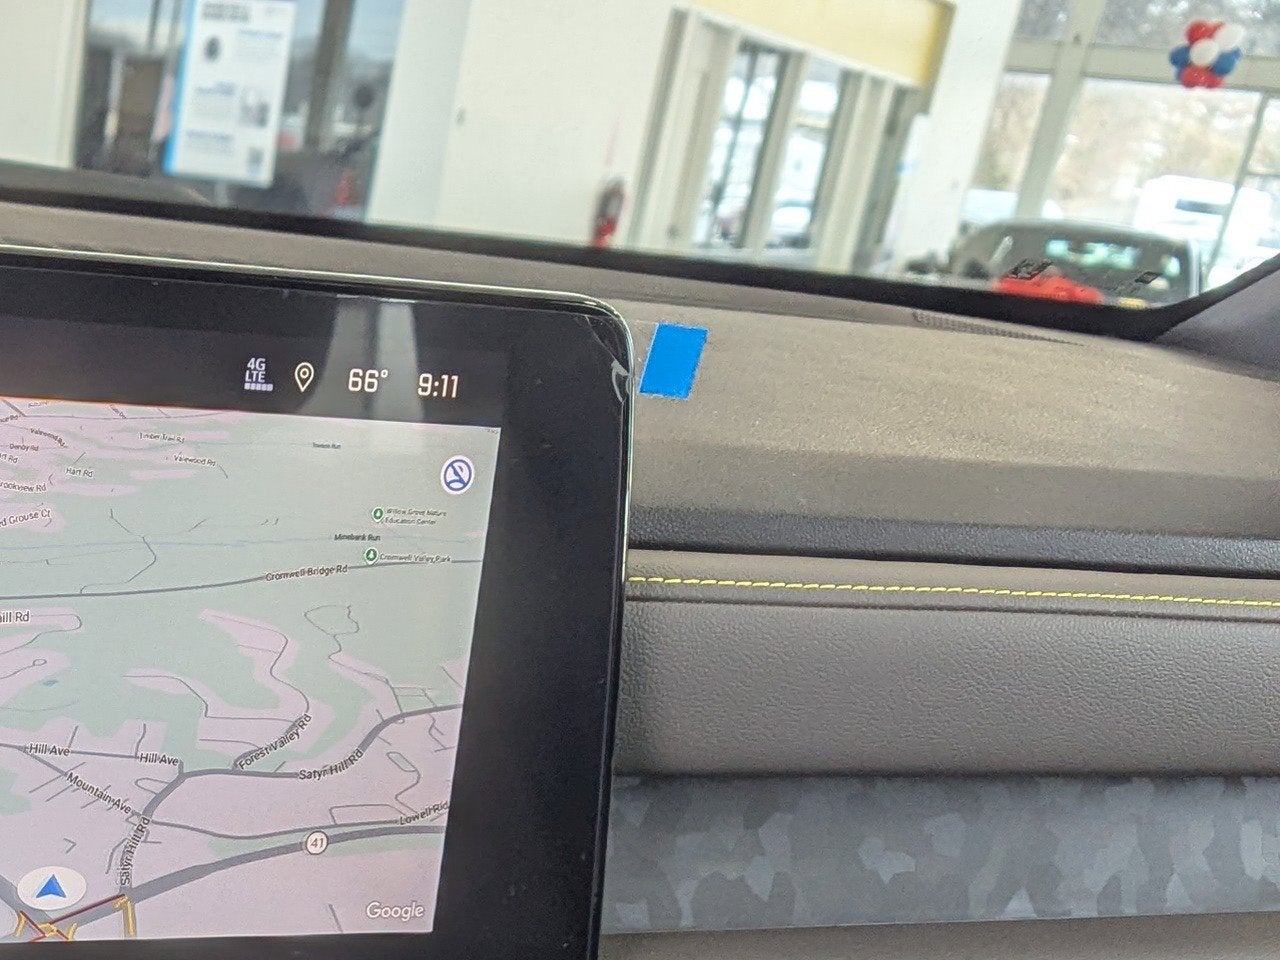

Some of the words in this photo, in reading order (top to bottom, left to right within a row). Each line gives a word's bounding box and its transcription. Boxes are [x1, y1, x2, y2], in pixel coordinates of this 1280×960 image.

[247, 357, 266, 370] 4G
[245, 370, 266, 382] LTE
[348, 368, 388, 392] 66°
[417, 373, 459, 398] 9:11
[8, 456, 18, 464] Rd
[65, 467, 81, 476] Hart
[82, 470, 94, 478] Rd
[36, 484, 47, 492] Rd
[9, 512, 39, 524] Grouse
[40, 509, 51, 518] Ct
[265, 569, 304, 582] Cromwell
[306, 566, 336, 579] Bridge
[336, 564, 348, 574] Rd
[14, 612, 30, 622] Rd
[29, 743, 48, 754] Hill
[49, 746, 70, 757] Ave
[238, 746, 270, 770] Forest
[269, 730, 300, 752] Valley
[298, 714, 312, 731] Rd
[139, 752, 158, 764] Hill
[158, 755, 180, 766] Ave
[298, 768, 326, 781] Satyr
[328, 762, 349, 776] Hill
[348, 748, 364, 766] Rd
[66, 772, 114, 804] Mountain
[113, 798, 132, 814] Ave
[136, 816, 151, 834] Rd
[400, 808, 430, 826] Lowell
[126, 833, 142, 854] Hill
[310, 838, 324, 848] 41
[120, 851, 134, 886] Satyr
[366, 902, 424, 922] Google
